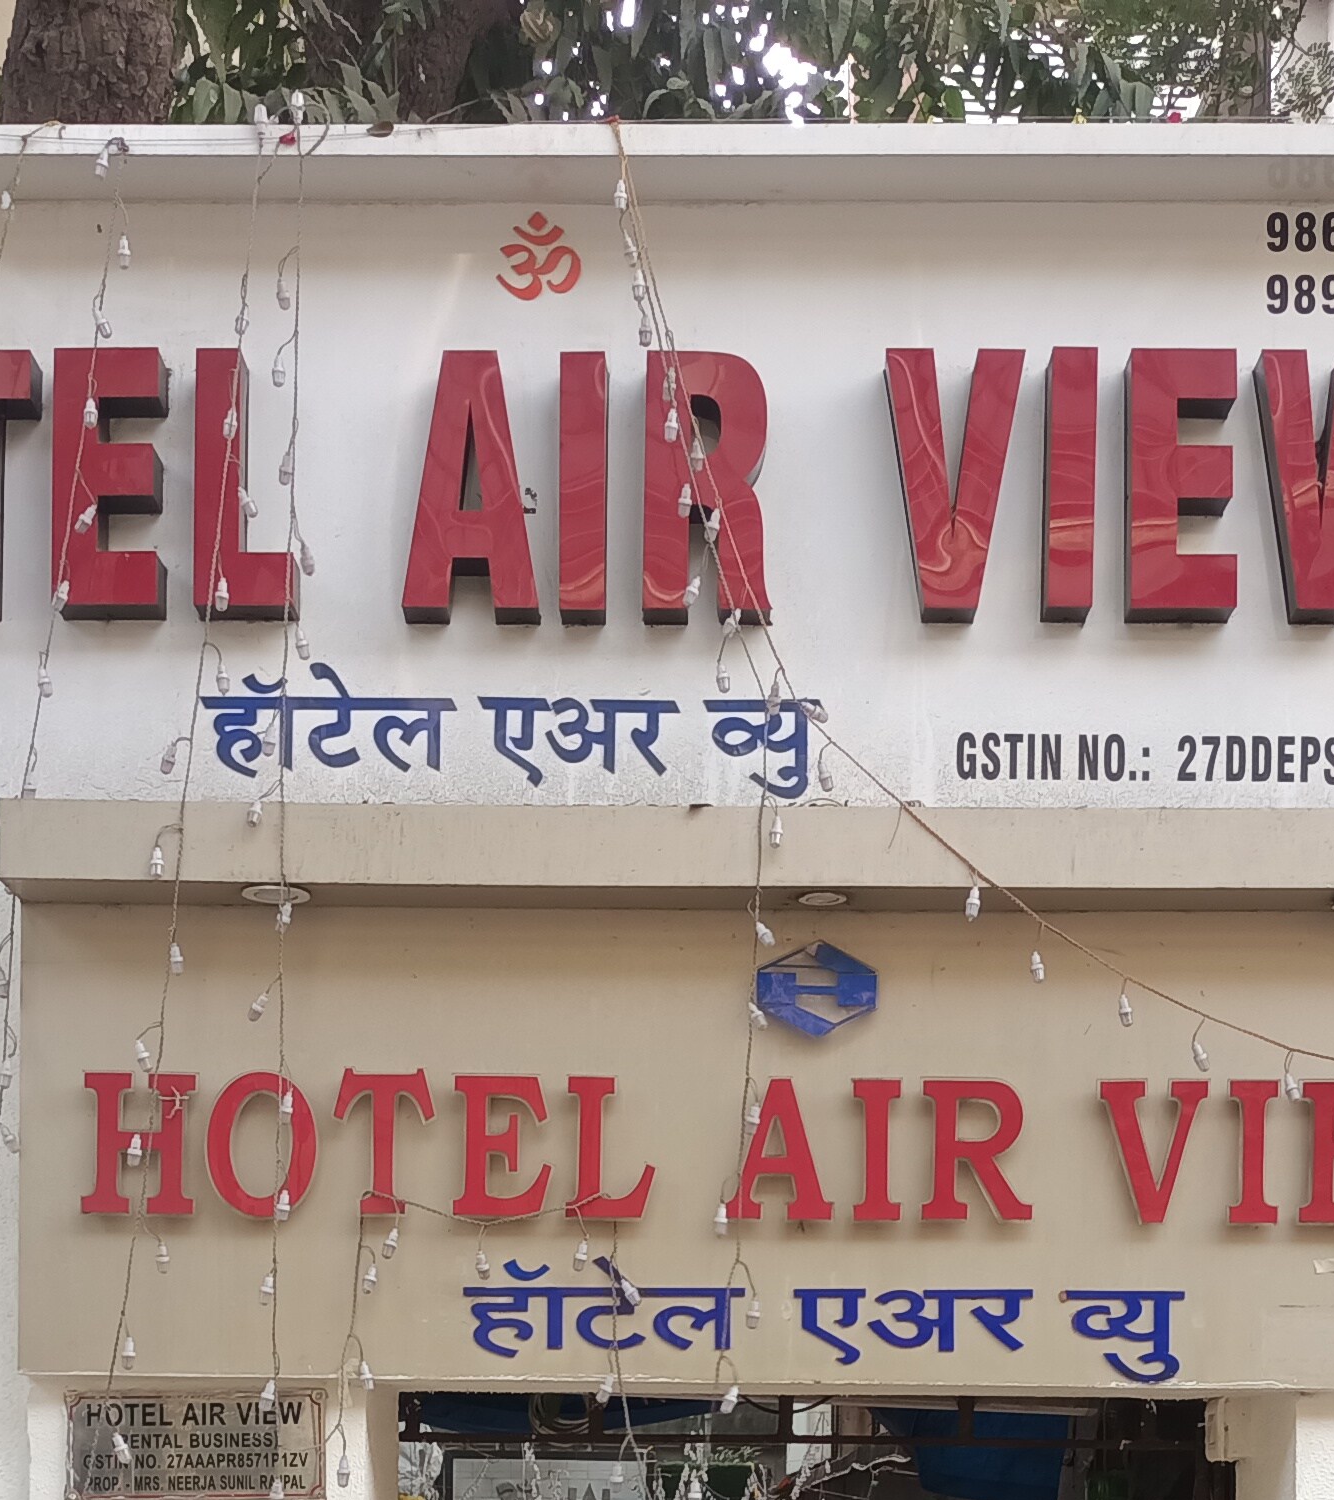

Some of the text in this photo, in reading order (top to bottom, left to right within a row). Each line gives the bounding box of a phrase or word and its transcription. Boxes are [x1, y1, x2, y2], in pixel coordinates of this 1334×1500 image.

[401, 349, 773, 627] AIR
[200, 662, 458, 779] हॉटेल
[476, 696, 681, 786] एअर
[955, 732, 1062, 782] GSTIN
[1077, 732, 1151, 783] NO.:
[79, 1066, 657, 1221] HOTEL
[726, 1076, 1034, 1222] AIR
[463, 1254, 746, 1358] हॉटेल
[793, 1288, 1034, 1367] एअर
[87, 1401, 303, 1427] HOTEL AIR VIEW
[111, 1430, 278, 1450] ENTAL BUSINESS)
[134, 1453, 161, 1470] NO.
[167, 1452, 309, 1469] 27AAAPR8571P1ZV
[134, 1475, 164, 1491] MRS.
[168, 1475, 217, 1491] NEERJA
[219, 1475, 255, 1490] SUNIL
[259, 1474, 307, 1490] RAPAL
